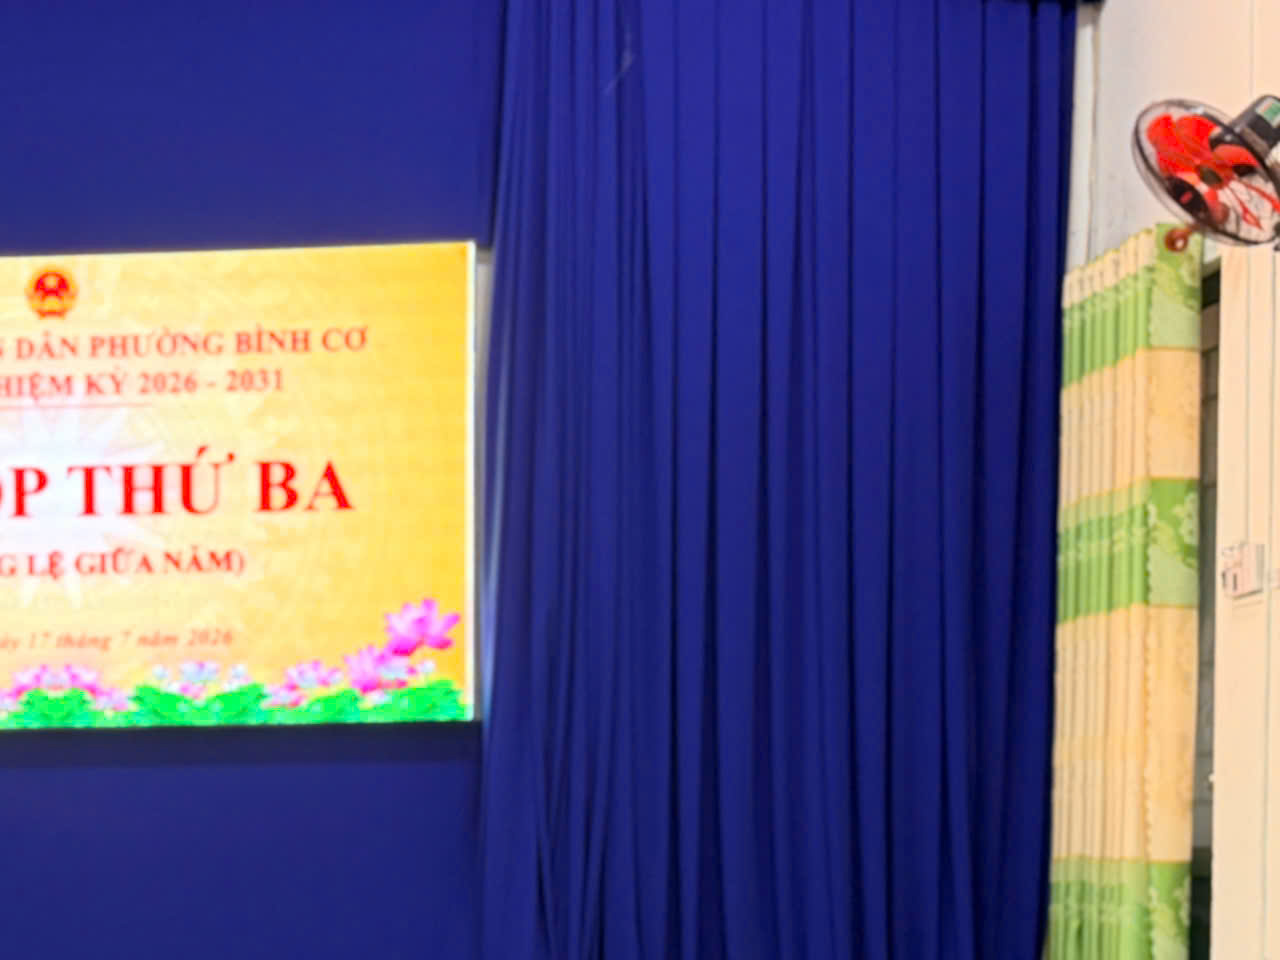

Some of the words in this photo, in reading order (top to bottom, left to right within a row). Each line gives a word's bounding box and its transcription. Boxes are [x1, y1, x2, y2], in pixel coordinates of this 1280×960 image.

[16, 330, 78, 360] DÂN
[89, 326, 224, 359] PHƯỜNG
[235, 323, 310, 355] BÌNH
[321, 326, 368, 352] CƠ
[139, 371, 197, 395] 2026
[225, 368, 284, 392] 2031
[66, 445, 236, 516] THỨ
[254, 459, 355, 512] BA
[27, 550, 64, 581] LỆ
[74, 547, 154, 575] GIỮA
[163, 545, 245, 575] NĂM)
